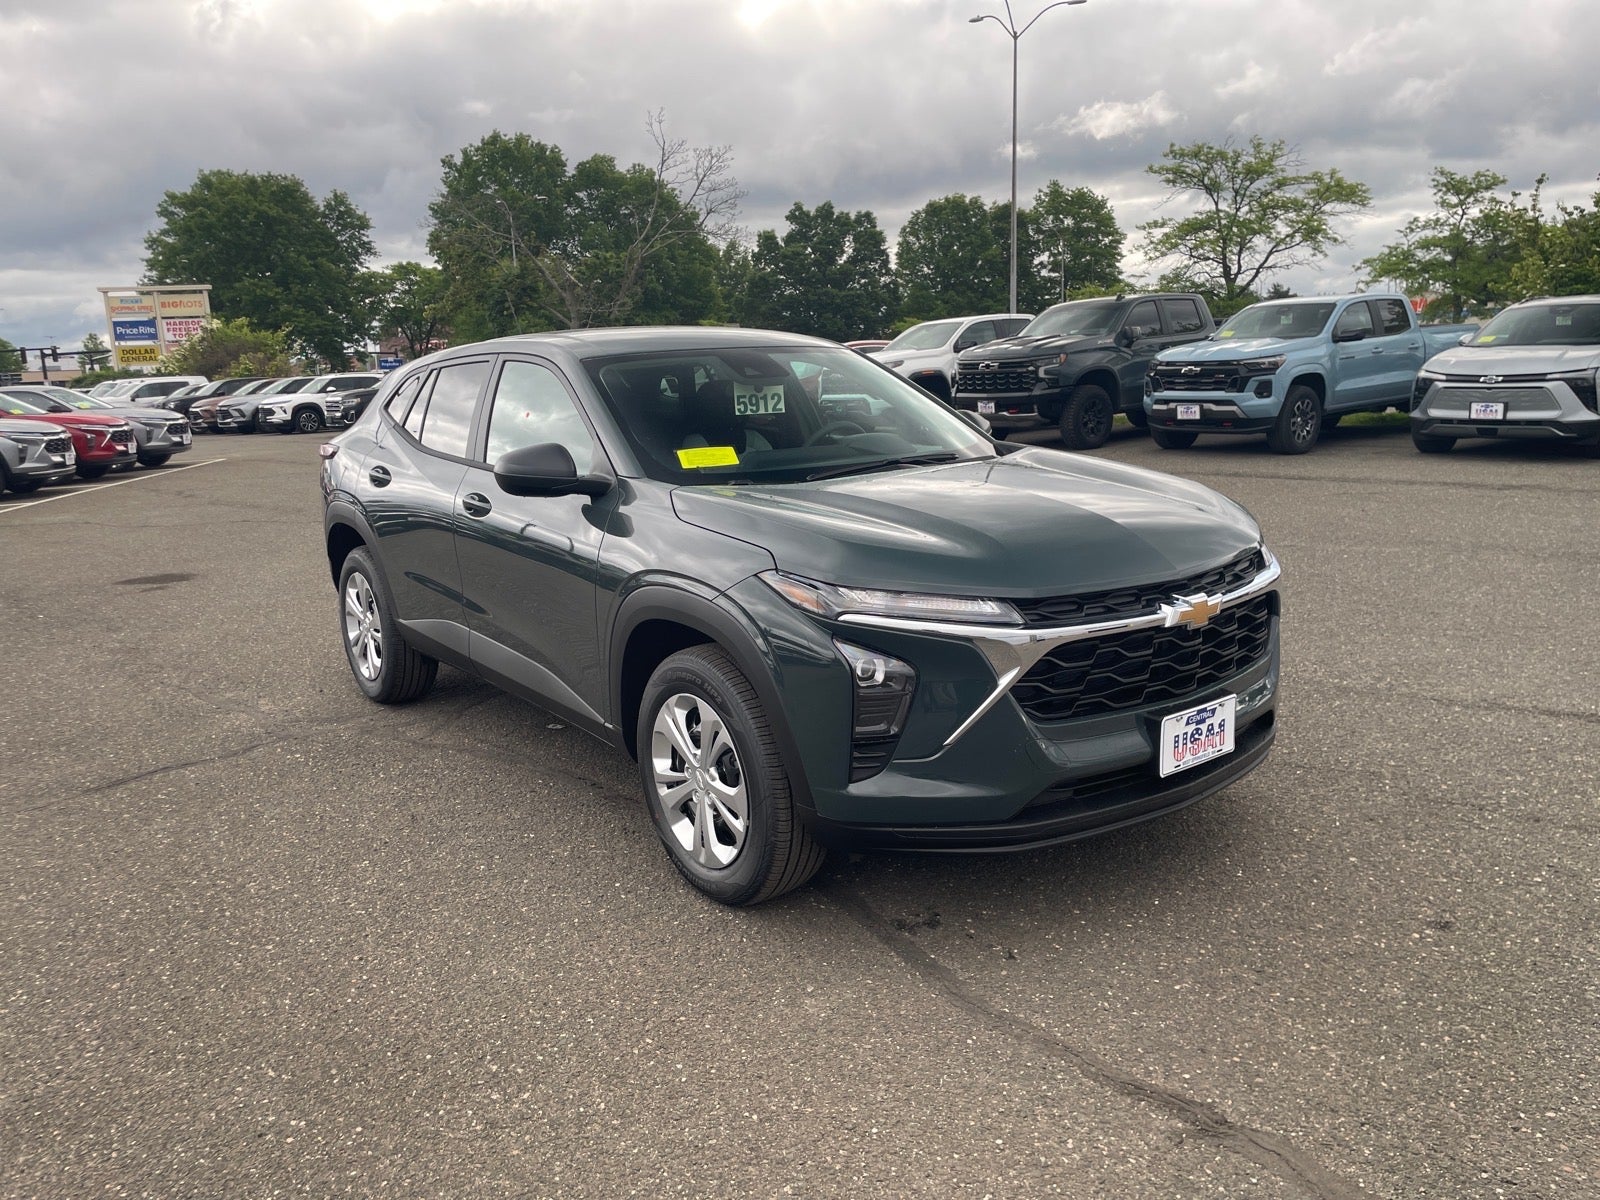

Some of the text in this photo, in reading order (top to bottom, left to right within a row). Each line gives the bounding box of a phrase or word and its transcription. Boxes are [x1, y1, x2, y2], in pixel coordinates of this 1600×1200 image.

[122, 348, 156, 356] DOLLAR
[736, 393, 783, 414] 5912
[1188, 710, 1213, 723] CENTRAL
